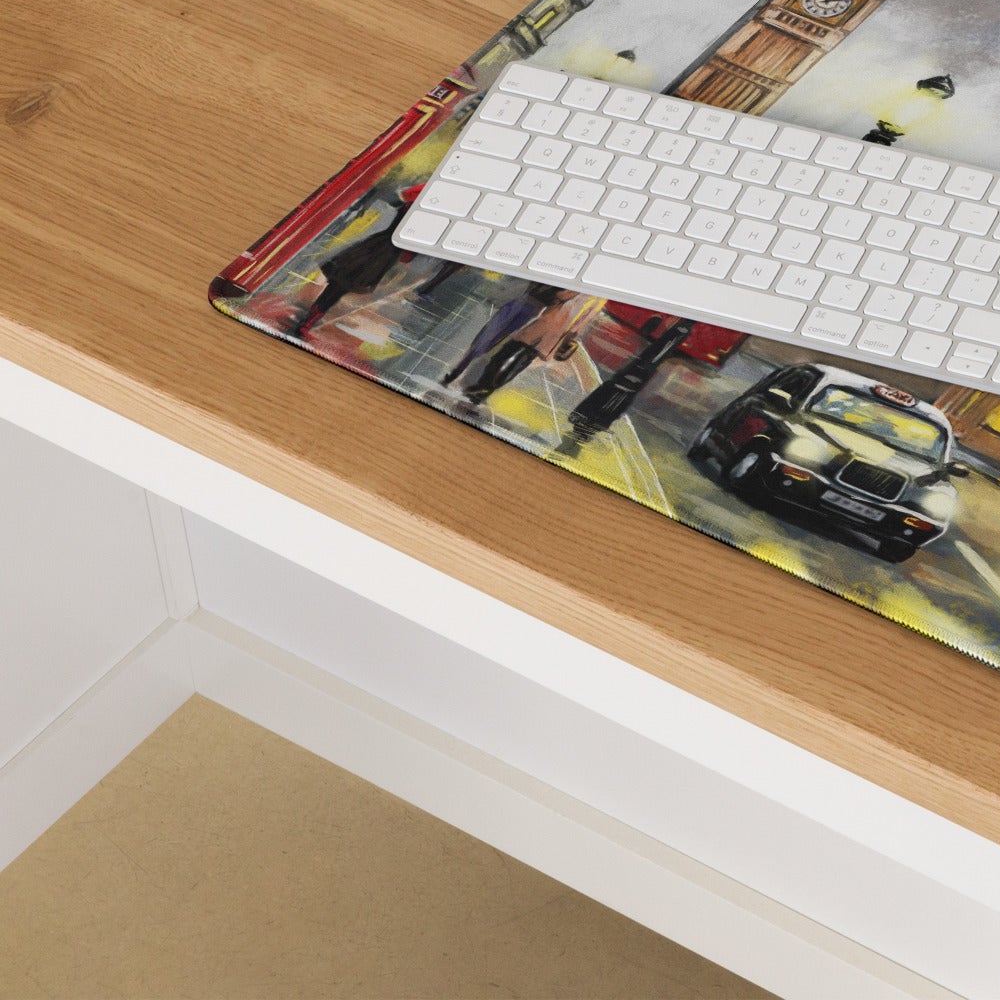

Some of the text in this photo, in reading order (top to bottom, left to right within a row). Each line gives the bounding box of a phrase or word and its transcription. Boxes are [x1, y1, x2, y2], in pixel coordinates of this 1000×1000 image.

[533, 181, 542, 189] A
[618, 200, 628, 208] D
[705, 221, 715, 230] G
[748, 232, 759, 240] H
[836, 252, 845, 260] K
[880, 262, 886, 271] L
[543, 148, 552, 157] Q
[585, 158, 597, 166] W
[670, 178, 679, 186] R
[800, 208, 809, 216] U
[886, 229, 896, 238] O
[536, 216, 807, 286] Z X C V B N M
